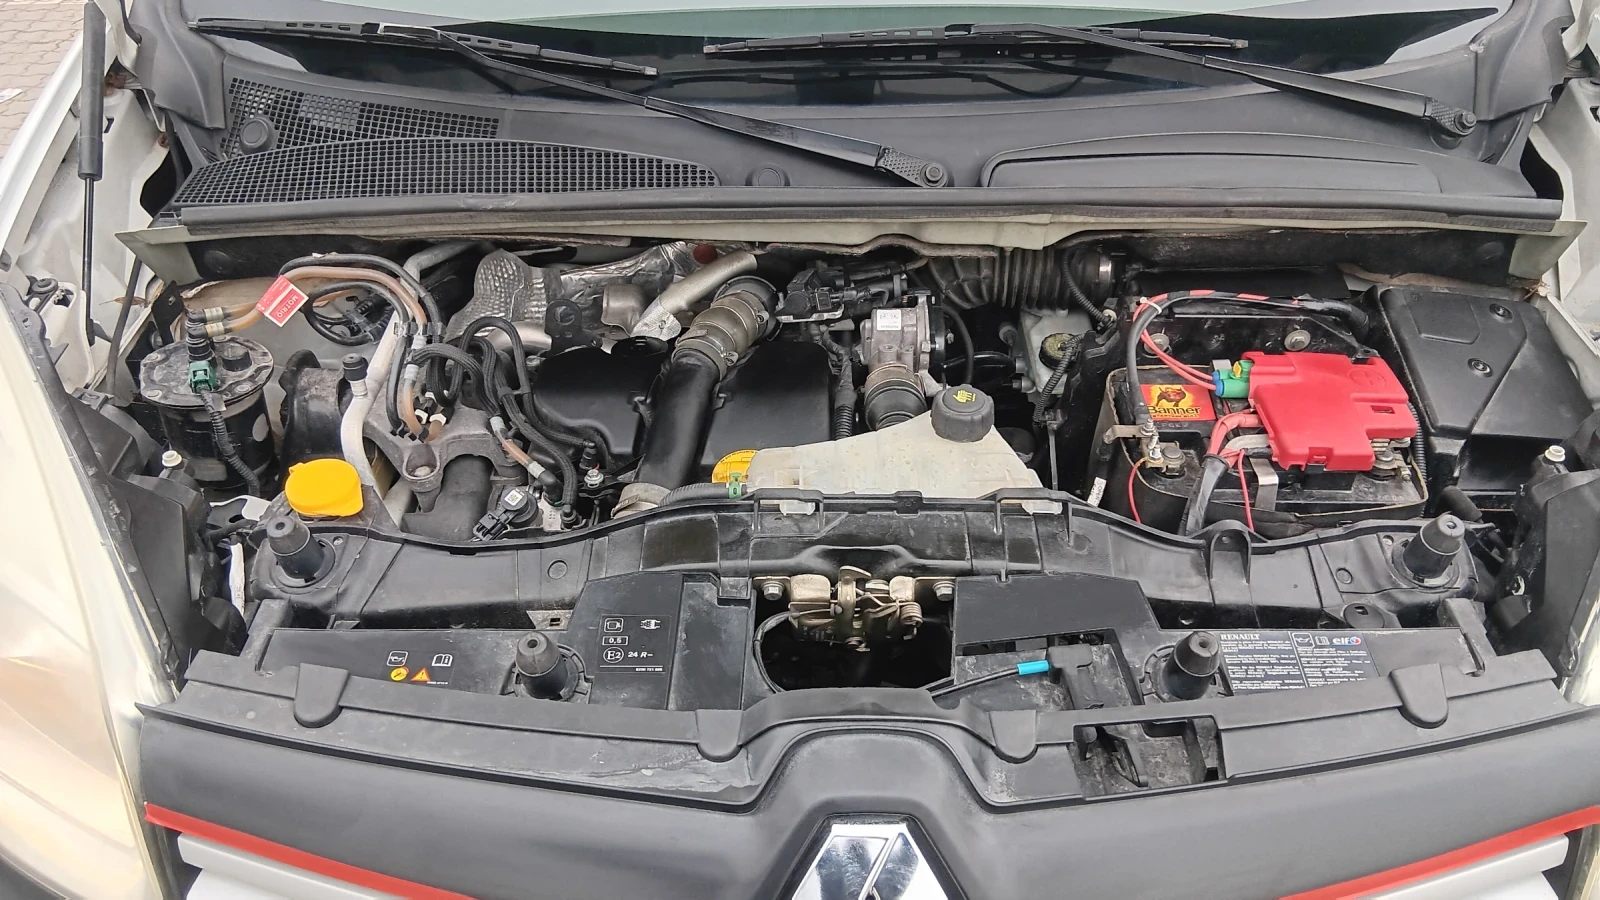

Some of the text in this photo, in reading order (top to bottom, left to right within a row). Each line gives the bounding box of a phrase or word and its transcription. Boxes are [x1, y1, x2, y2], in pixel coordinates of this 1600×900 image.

[277, 294, 299, 317] MOTRIO
[1147, 405, 1200, 414] Banner
[607, 650, 621, 660] E2
